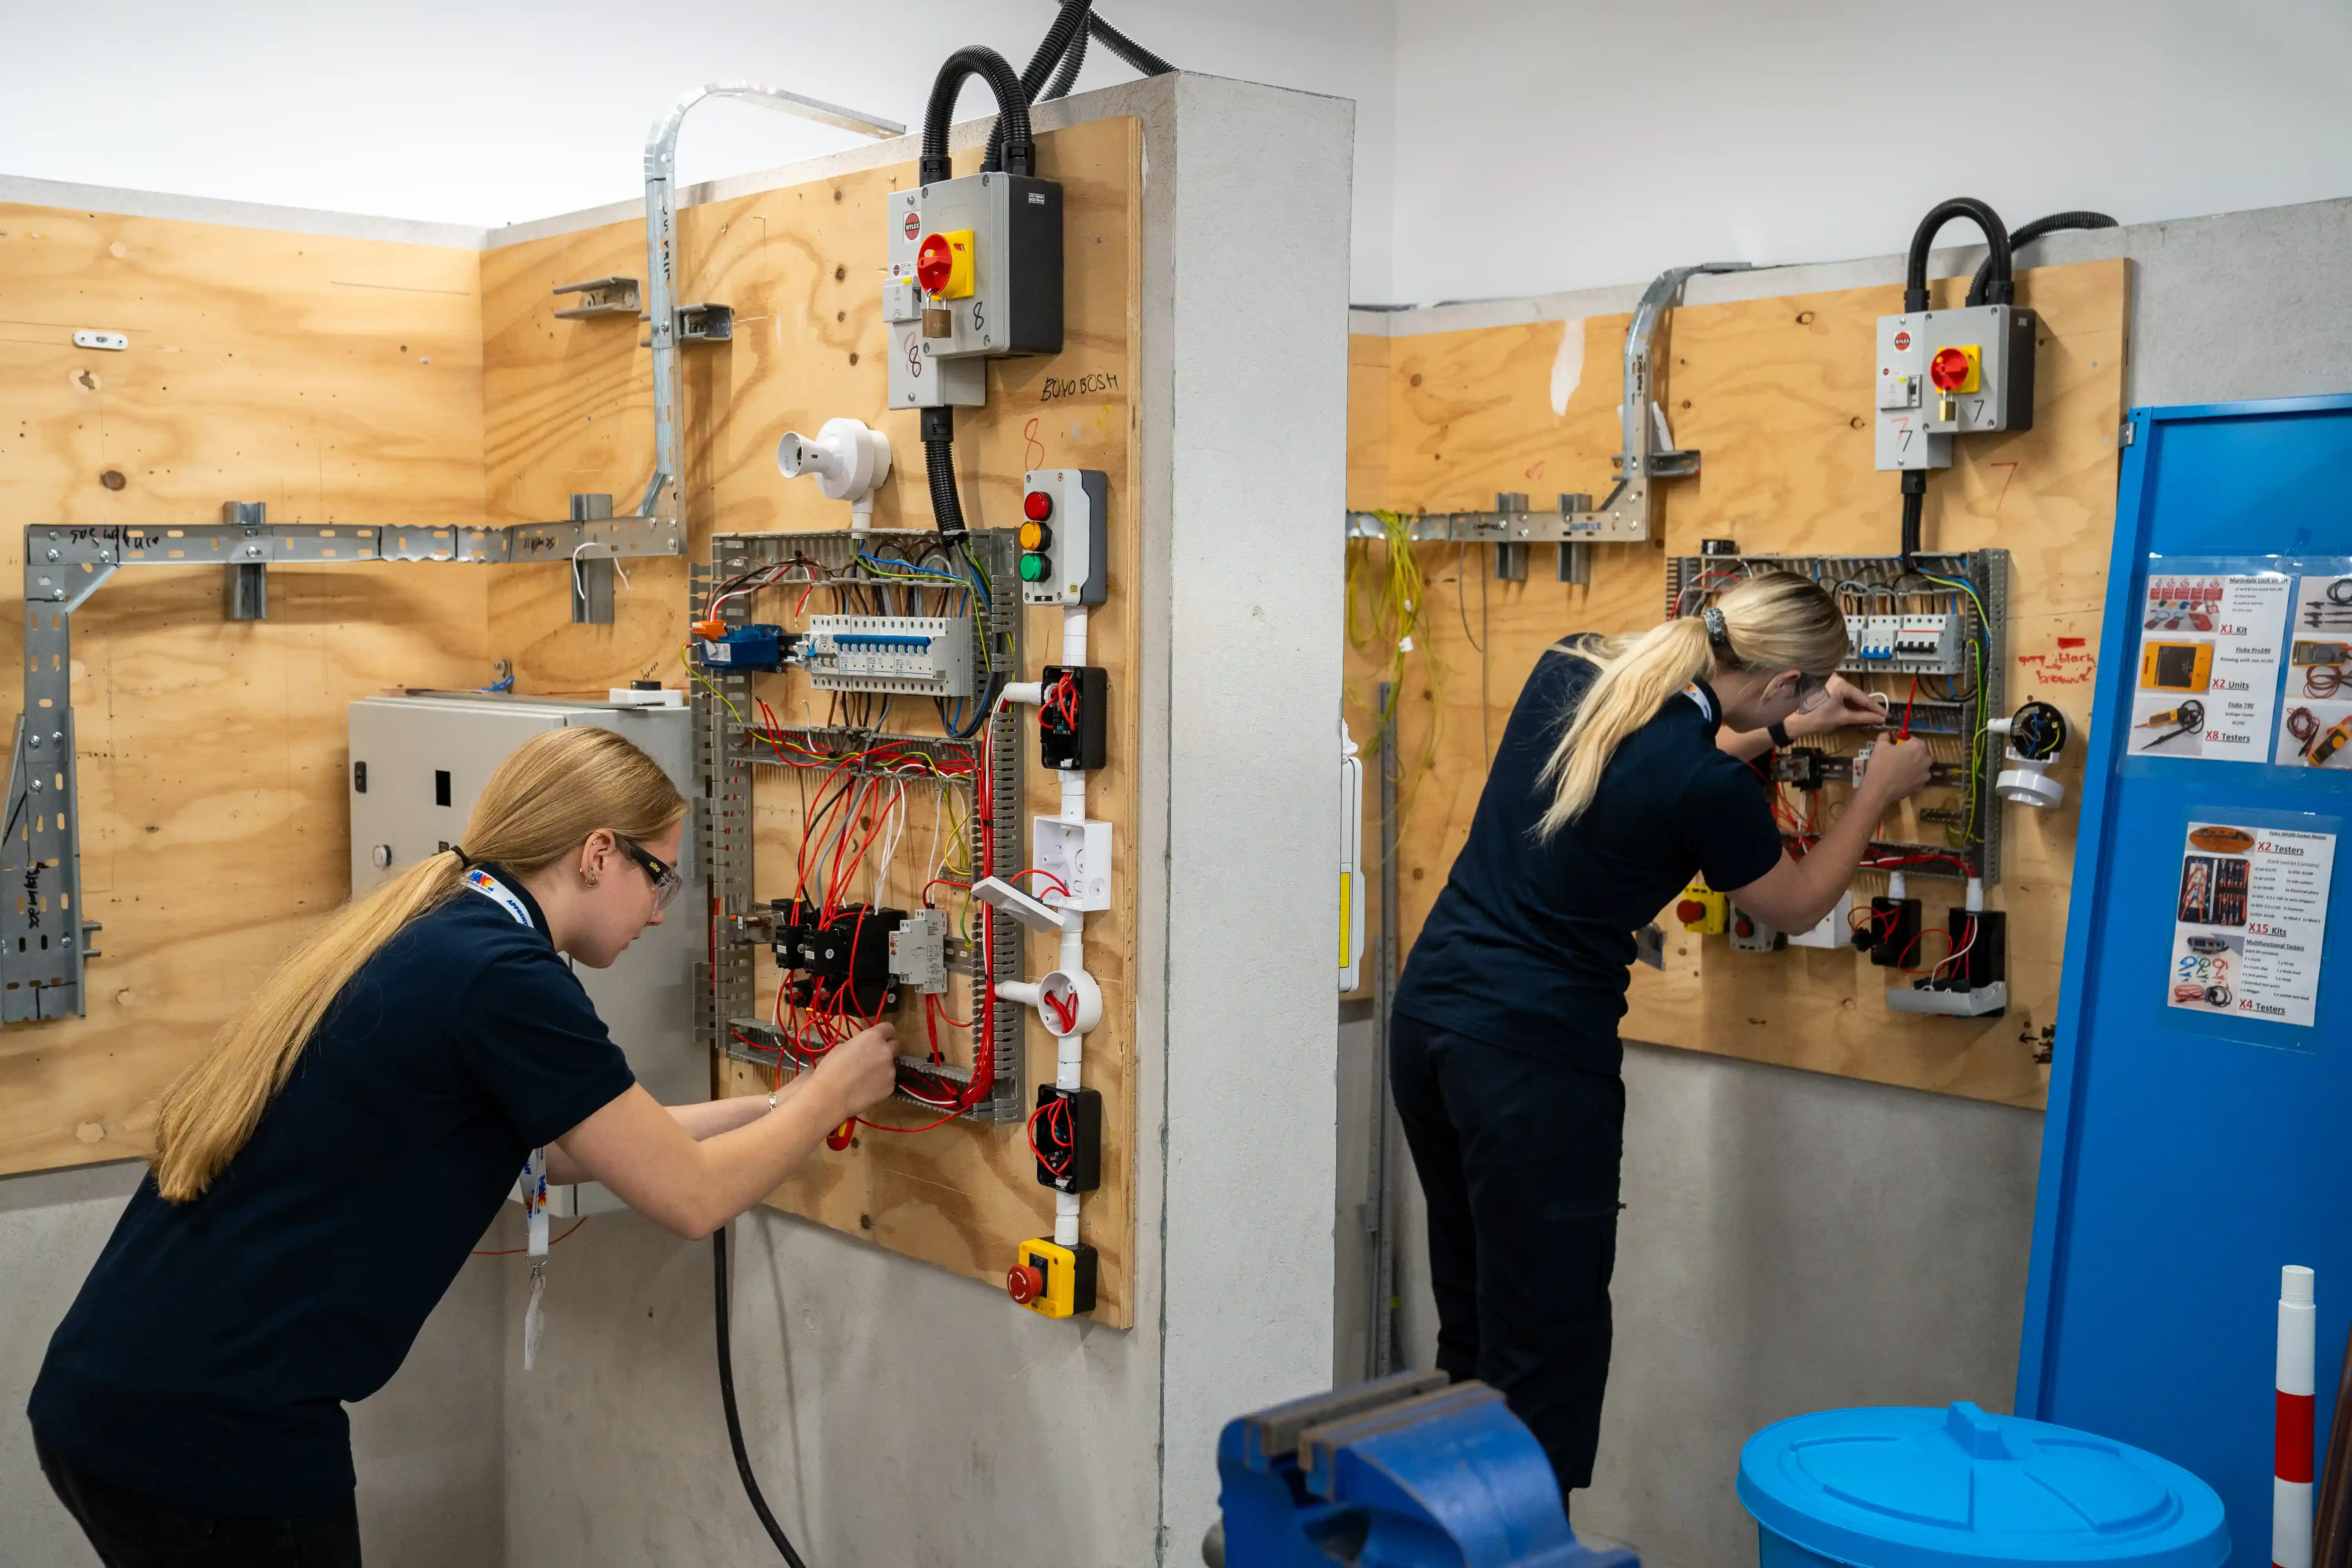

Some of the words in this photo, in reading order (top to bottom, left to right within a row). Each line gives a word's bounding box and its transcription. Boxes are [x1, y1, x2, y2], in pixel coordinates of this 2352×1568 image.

[973, 301, 984, 331] 8
[909, 345, 922, 377] 8
[1080, 373, 1119, 394] BOSH
[1974, 400, 1984, 423] 7
[1024, 418, 1044, 472] 8
[1900, 430, 1913, 452] 7
[1991, 463, 2018, 512] 7
[2221, 624, 2233, 633] X1
[2237, 626, 2247, 634] Kit
[2059, 653, 2096, 664] black
[2213, 679, 2225, 688] X2
[2229, 681, 2249, 689] Units
[2205, 731, 2218, 740] X8
[2221, 733, 2250, 742] Testers
[2258, 842, 2271, 851] X2
[2275, 845, 2304, 854] Testers
[650, 862, 660, 872] site
[2249, 922, 2269, 933] X15
[2272, 927, 2287, 936] Kits
[2247, 939, 2285, 949] Multifunctional
[2239, 999, 2253, 1009] X4
[2256, 1003, 2285, 1014] Testers
